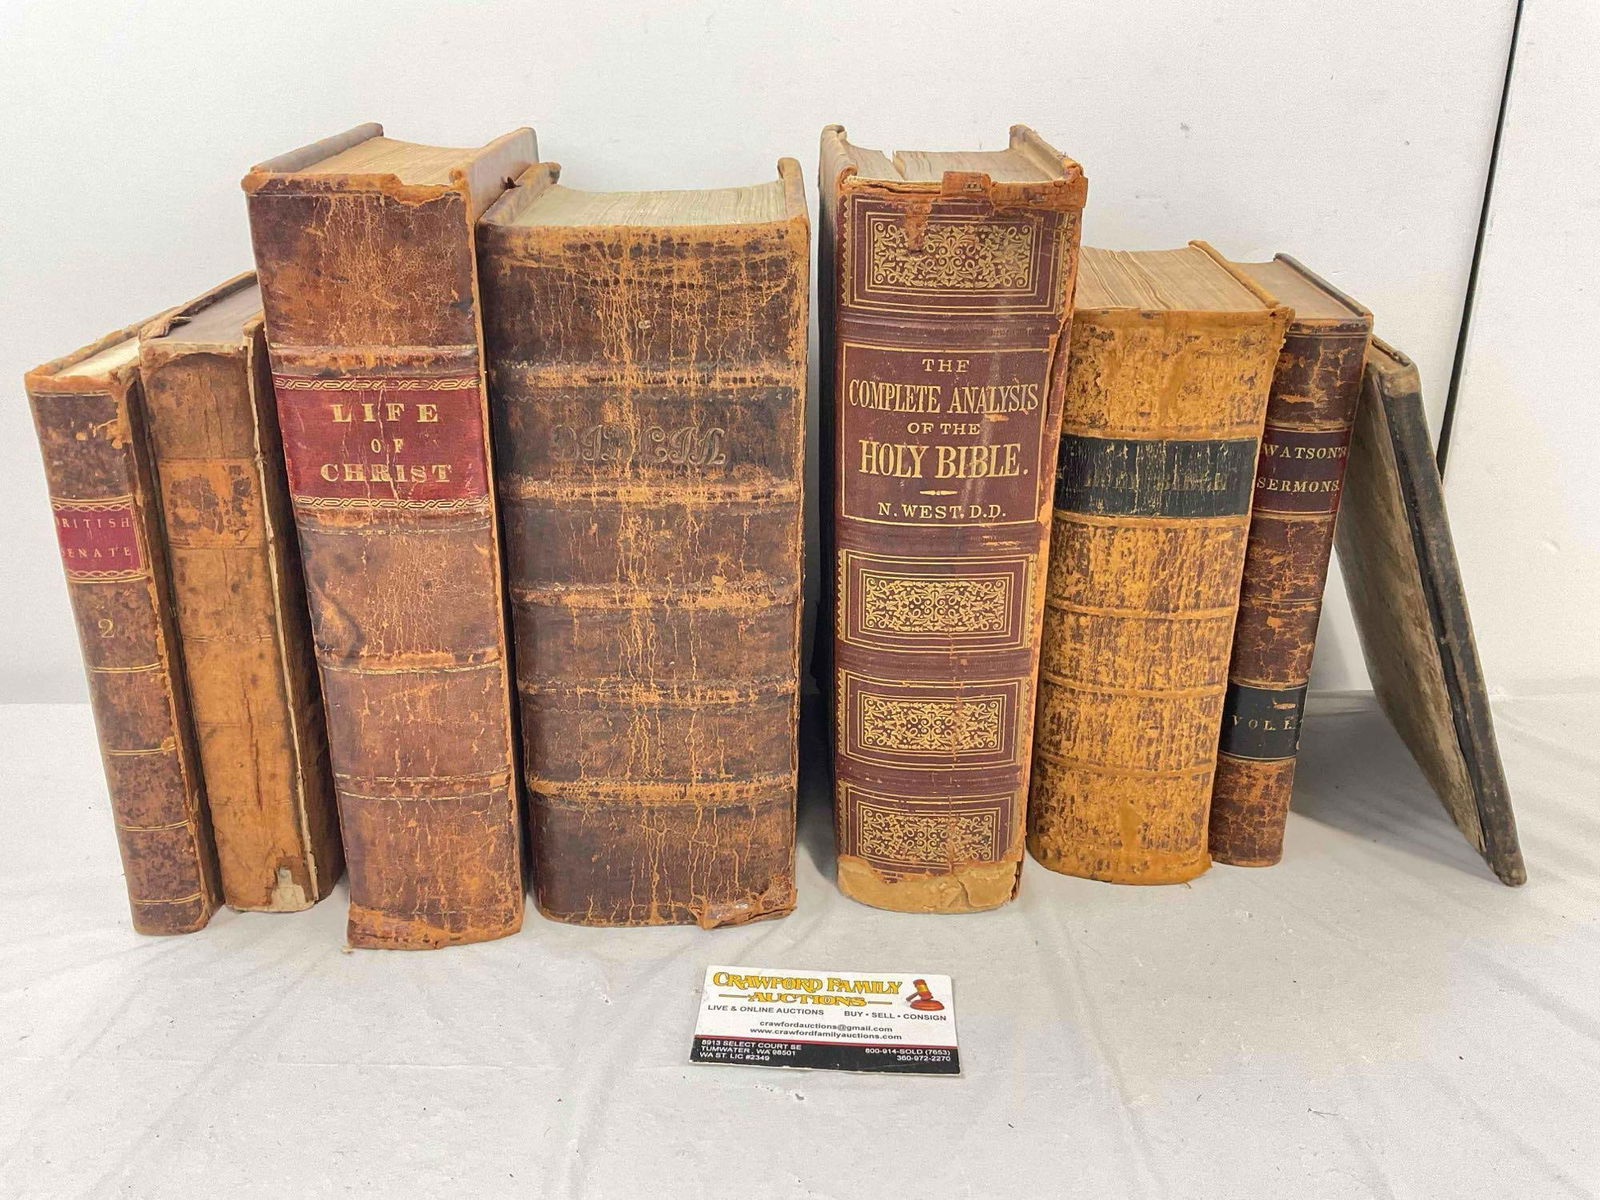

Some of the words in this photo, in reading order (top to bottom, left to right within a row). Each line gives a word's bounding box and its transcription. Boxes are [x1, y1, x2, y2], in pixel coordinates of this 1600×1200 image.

[922, 358, 970, 373] THE
[849, 378, 941, 414] COMPLETE
[947, 383, 1039, 414] ANALYSIS
[331, 403, 439, 423] LIFE
[907, 422, 934, 434] OF
[940, 423, 981, 435] THE
[371, 438, 405, 453] OF
[1263, 443, 1347, 460] WATSON'S
[858, 439, 930, 479] HOLY
[935, 442, 1029, 479] BIBLE.
[320, 463, 453, 483] CHRIST
[878, 502, 898, 518] N.
[968, 504, 1007, 519] D.D.
[97, 617, 115, 639] 2
[713, 971, 823, 993] CRAWFORD
[826, 977, 903, 995] FAMILY
[748, 991, 867, 1007] AUCTIONS
[708, 1004, 728, 1012] LIVE
[740, 1006, 775, 1014] ONLINE
[776, 1007, 824, 1016] AUCTIONS
[903, 1013, 947, 1021] CONSIGN
[750, 1028, 903, 1040] www.crawfordfamilyauctions.com
[759, 1021, 893, 1033] crawfordauctions@gmail.com
[723, 1040, 756, 1048] SELECT
[865, 1047, 923, 1055] 800-914-SOLD
[925, 1048, 951, 1056] (7653)
[897, 1054, 951, 1062] 360-972-2270
